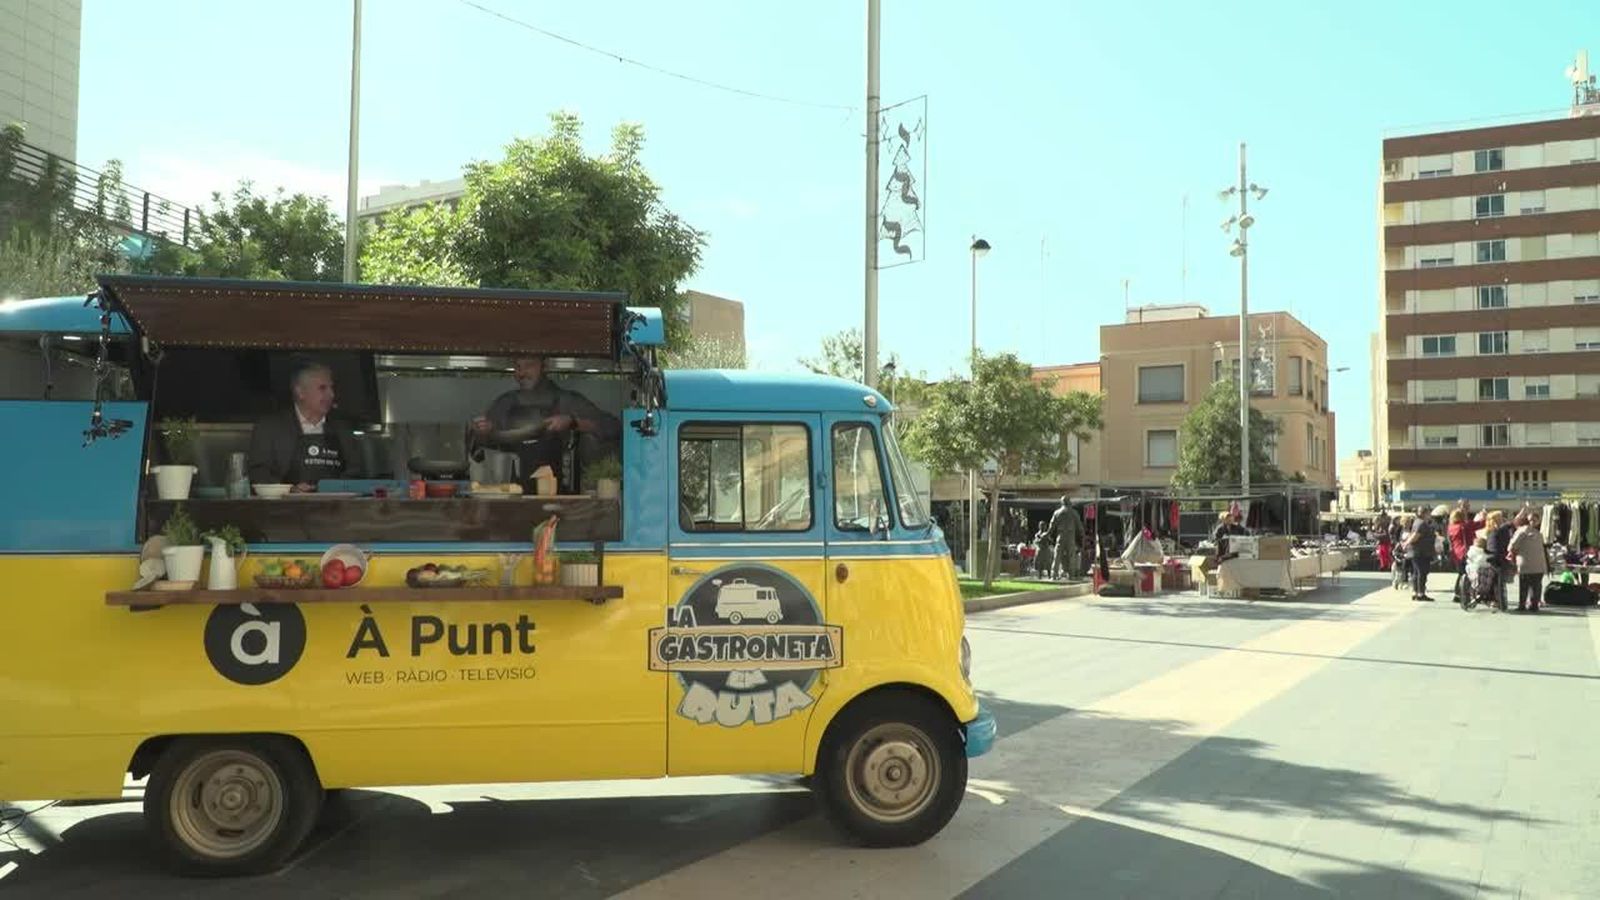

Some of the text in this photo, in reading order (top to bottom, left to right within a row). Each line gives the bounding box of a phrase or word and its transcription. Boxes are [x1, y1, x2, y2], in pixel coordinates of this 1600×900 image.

[346, 604, 536, 658] À Punt
[665, 605, 697, 628] LA
[659, 633, 835, 663] GASTRONETA
[346, 665, 536, 684] WEB RÀDIO TELEVISIÓ
[676, 680, 816, 727] RUTA
